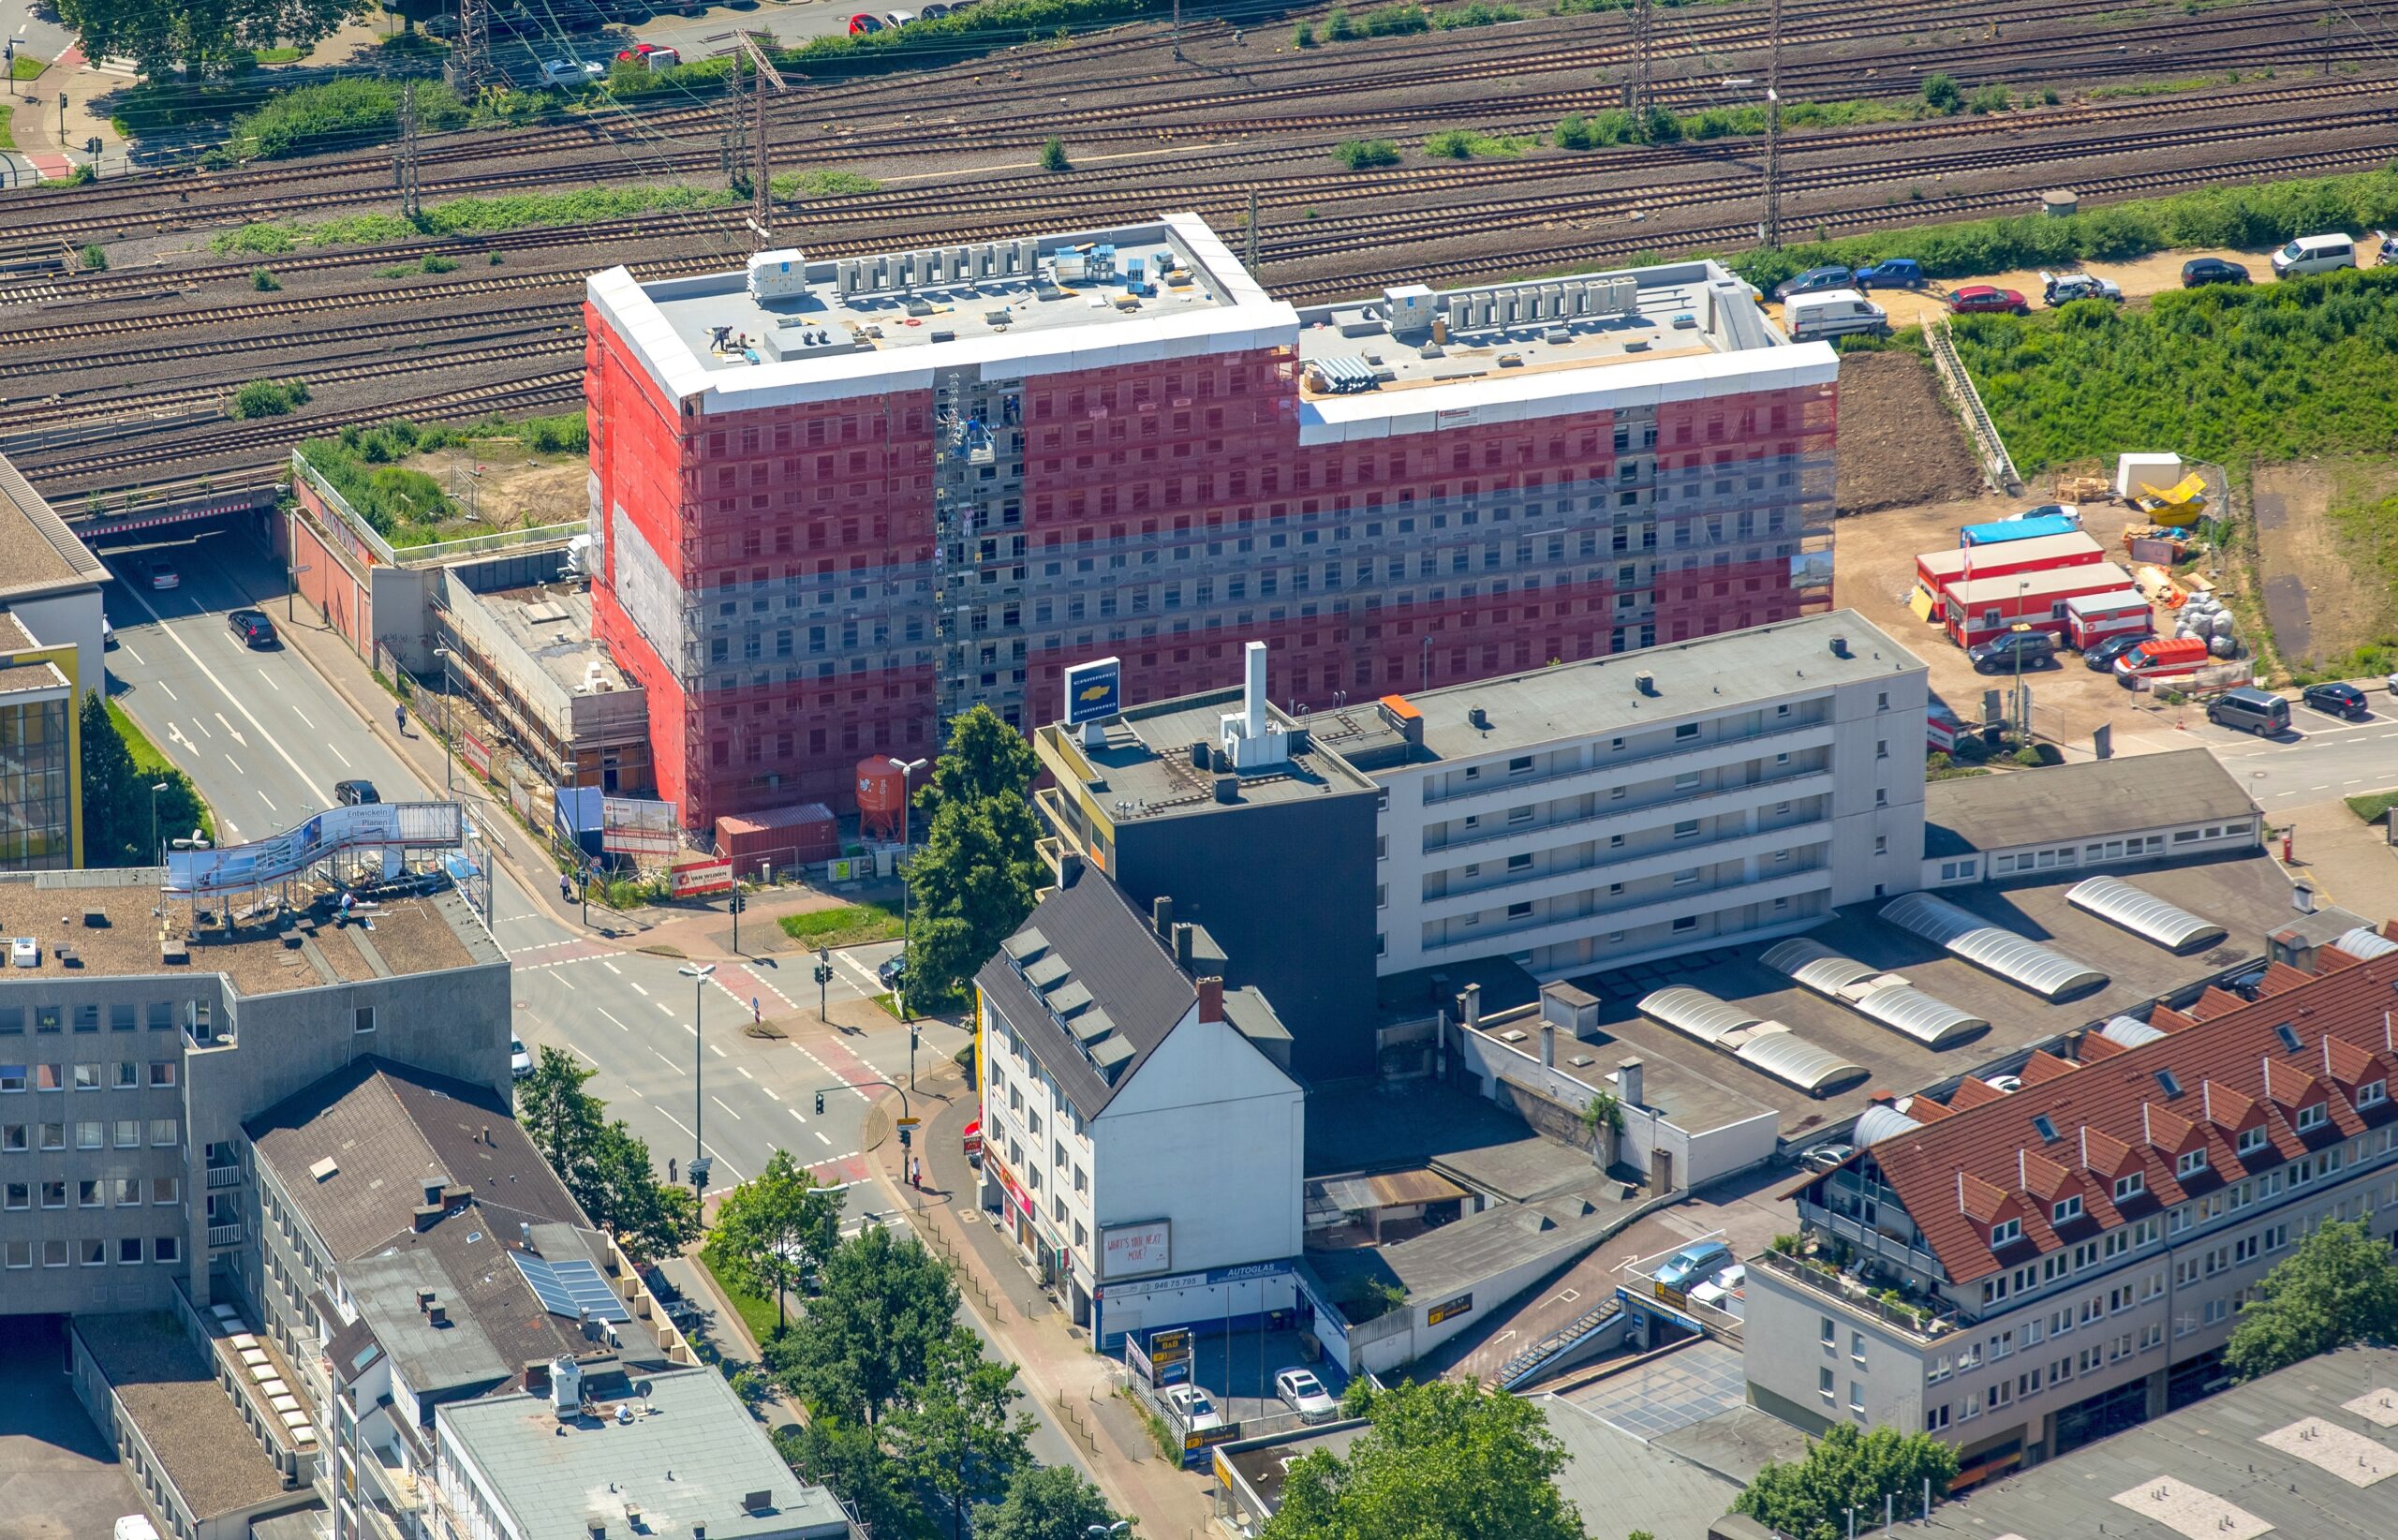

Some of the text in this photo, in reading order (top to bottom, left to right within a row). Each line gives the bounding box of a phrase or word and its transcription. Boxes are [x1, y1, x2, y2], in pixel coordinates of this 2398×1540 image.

[1073, 672, 1116, 685] CAMARO
[1073, 702, 1116, 716] CAMARO
[347, 808, 388, 817] Entwickeln
[1108, 1237, 1129, 1251] WHAT'S
[1146, 1233, 1162, 1244] NEXT
[1128, 1245, 1147, 1261] MOVE?
[1228, 1264, 1274, 1276] AUTOGLAS
[1155, 1281, 1168, 1290] 946
[1171, 1280, 1180, 1288] 75
[1182, 1277, 1196, 1286] 795
